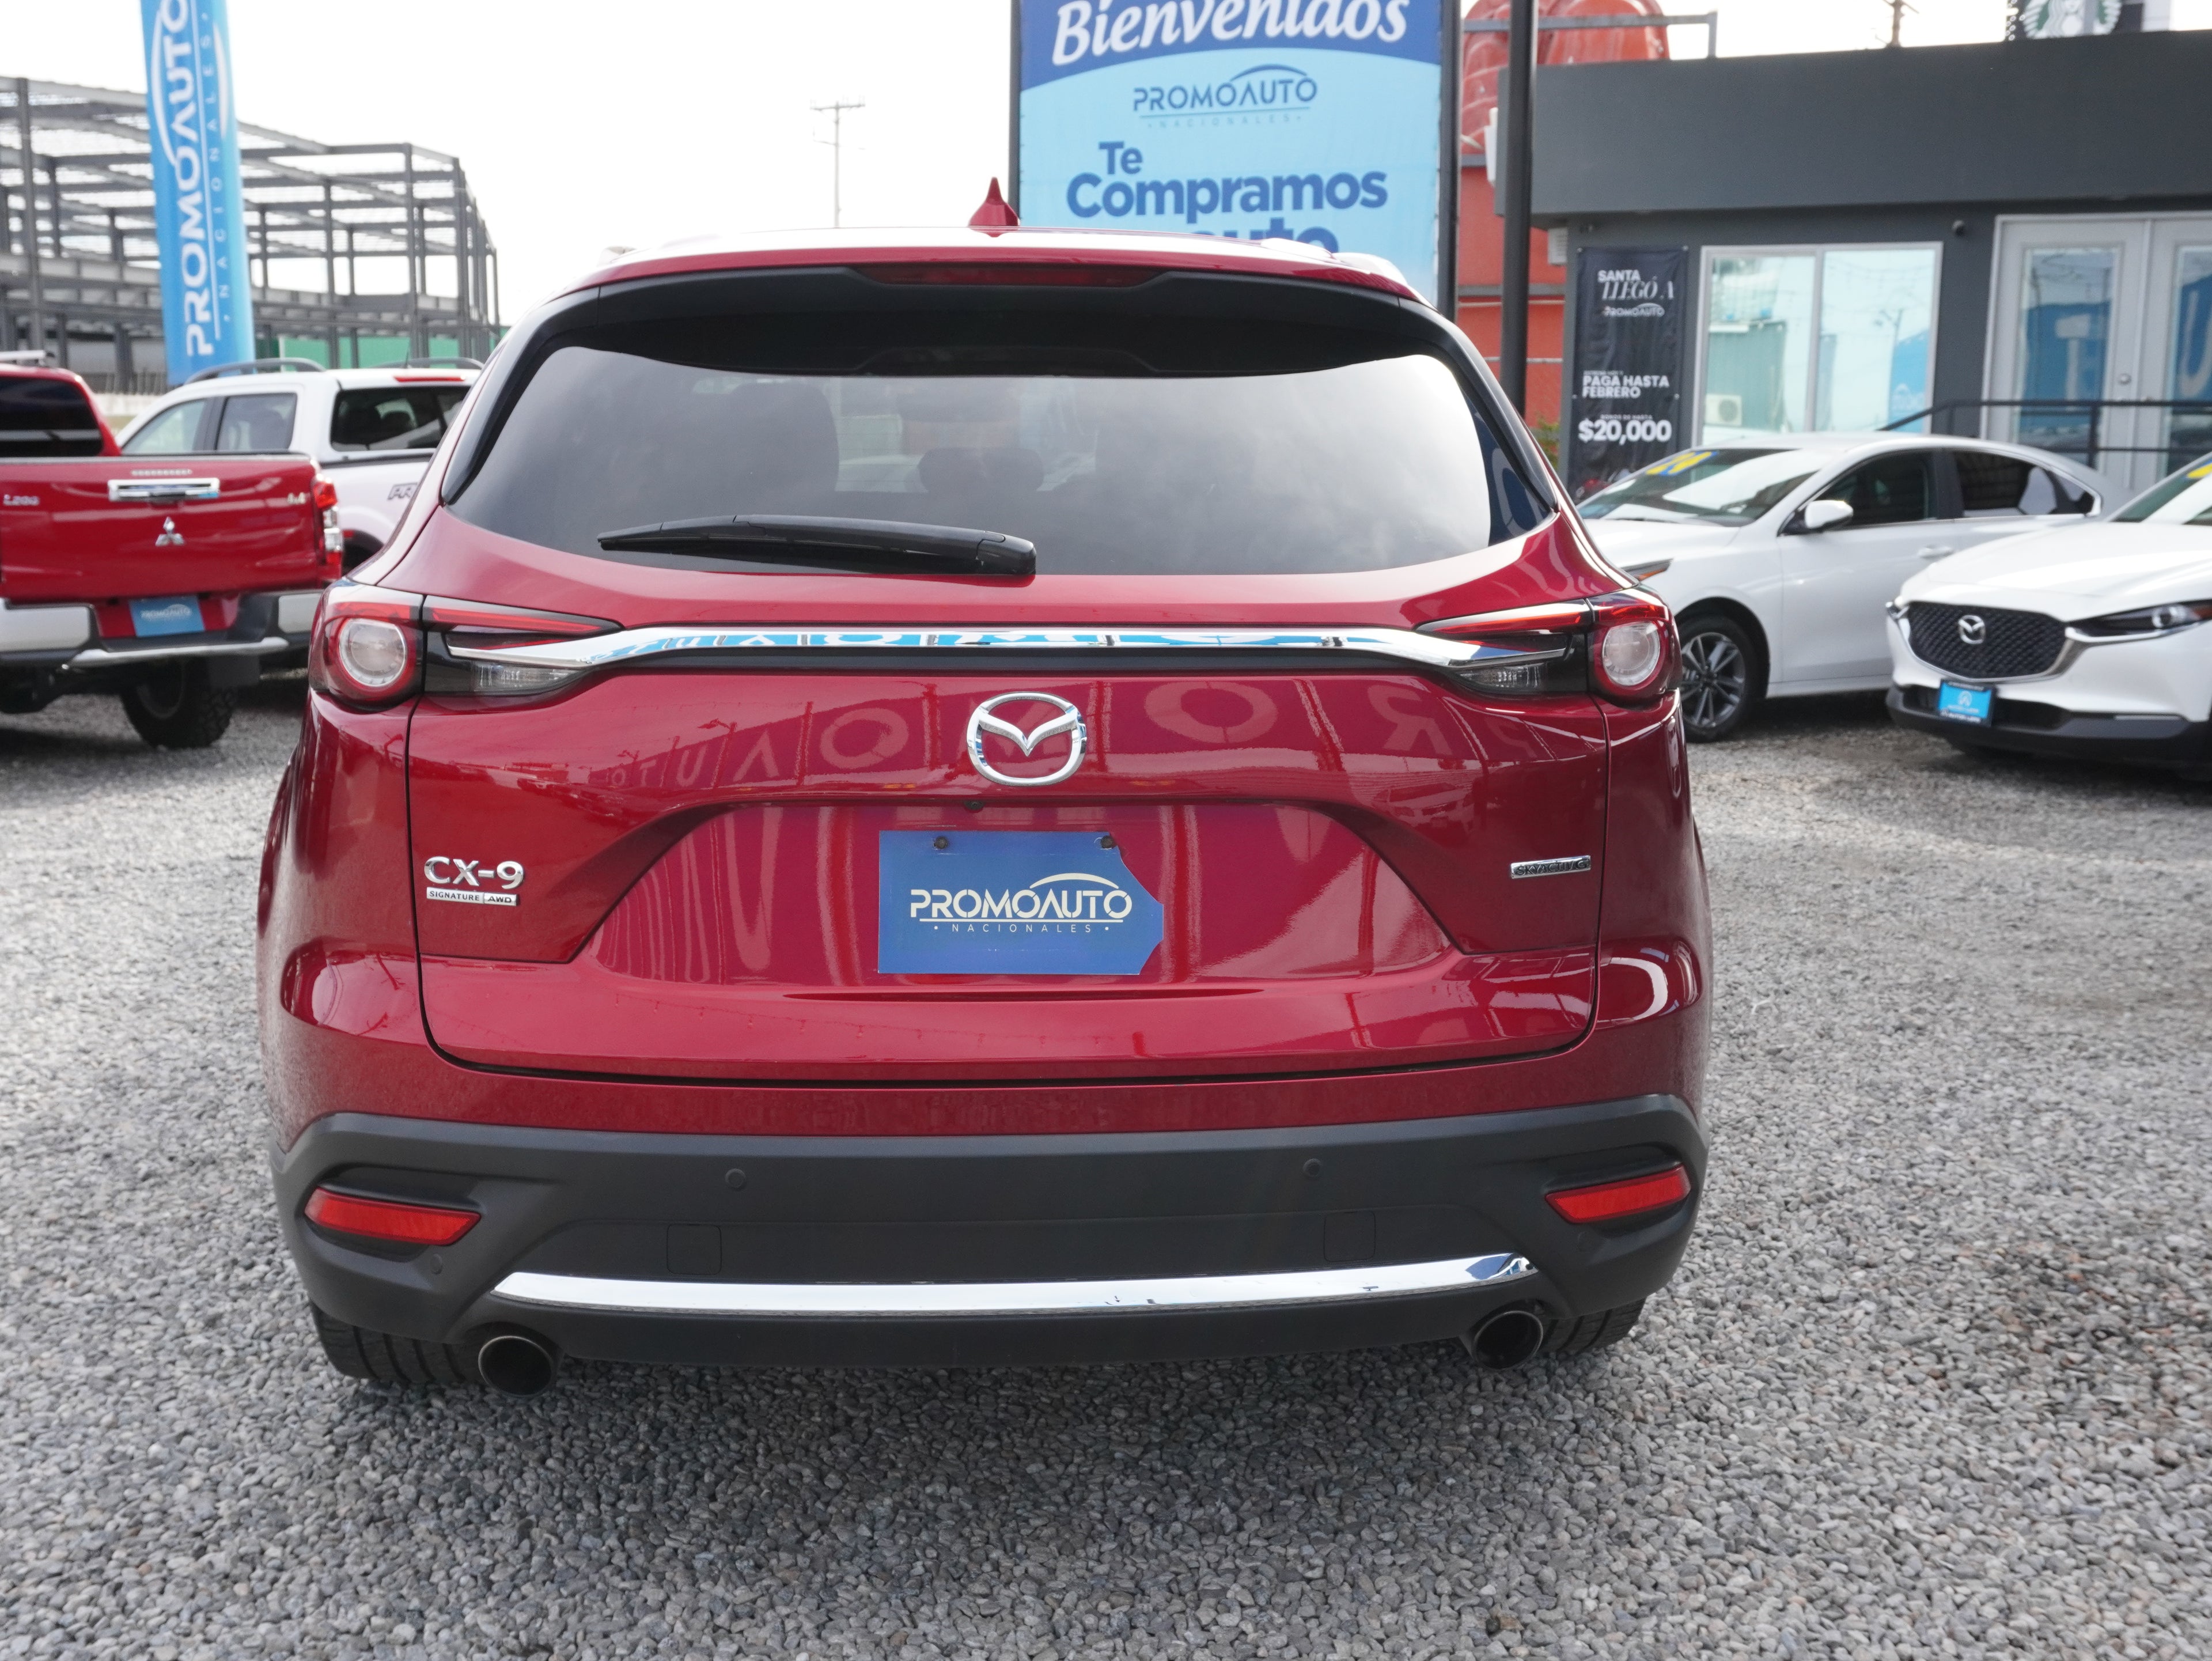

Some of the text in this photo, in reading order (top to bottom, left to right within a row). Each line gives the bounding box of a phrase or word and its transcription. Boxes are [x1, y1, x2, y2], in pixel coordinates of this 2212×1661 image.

[1052, 0, 1408, 66] Bienvenidos
[1133, 78, 1317, 111] PROMOAUTO
[200, 35, 230, 299] NACIONALES
[1099, 141, 1143, 174] Te
[161, 0, 214, 357] PROMOAUTO
[1067, 171, 1388, 224] Compramos
[1597, 269, 1642, 283] SANTA
[1582, 387, 1641, 398] FEBRERO
[1583, 375, 1670, 388] PAGA HASTA
[1578, 418, 1672, 445] $20,000
[424, 856, 524, 890] CX-9
[429, 891, 480, 902] SIGNATURE
[911, 888, 1132, 918] PROMOAUTO
[952, 924, 1091, 933] NACIONALES
